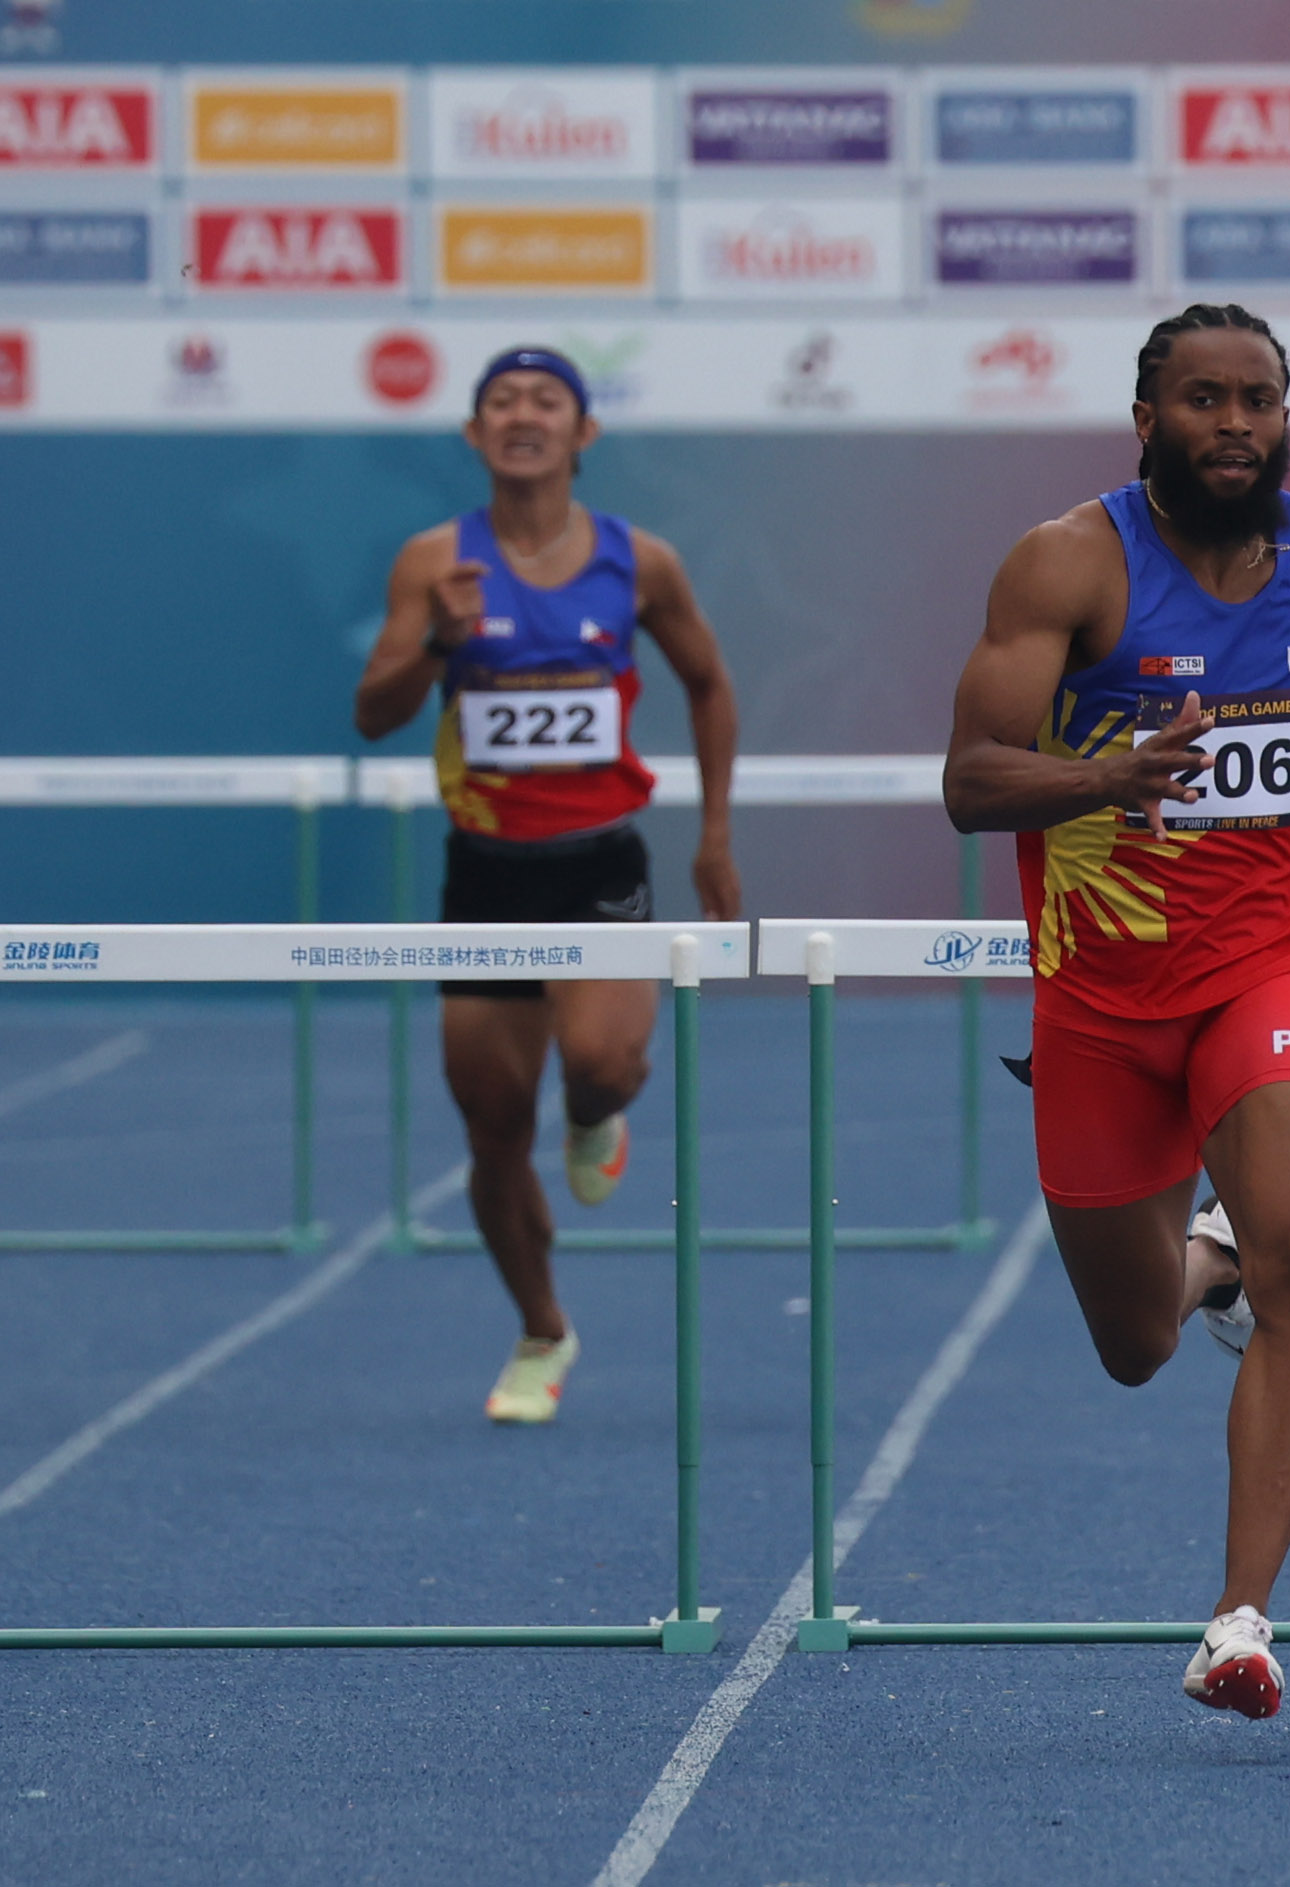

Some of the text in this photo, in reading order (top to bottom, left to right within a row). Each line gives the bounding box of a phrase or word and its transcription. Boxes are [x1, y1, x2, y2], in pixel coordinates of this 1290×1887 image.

[214, 211, 381, 275] AIA
[1174, 658, 1202, 668] ICTSI
[1220, 704, 1248, 718] SEA
[487, 704, 597, 747] 222
[1174, 818, 1214, 829] SPORTS
[1239, 818, 1249, 828] IN
[1252, 815, 1280, 828] PEACE
[3, 941, 100, 960] 金陵体育
[291, 945, 584, 967] 中国田径协会田径器材类官方供应商
[987, 937, 1031, 956] 金陵
[2, 962, 98, 970] JINLING SPORTS
